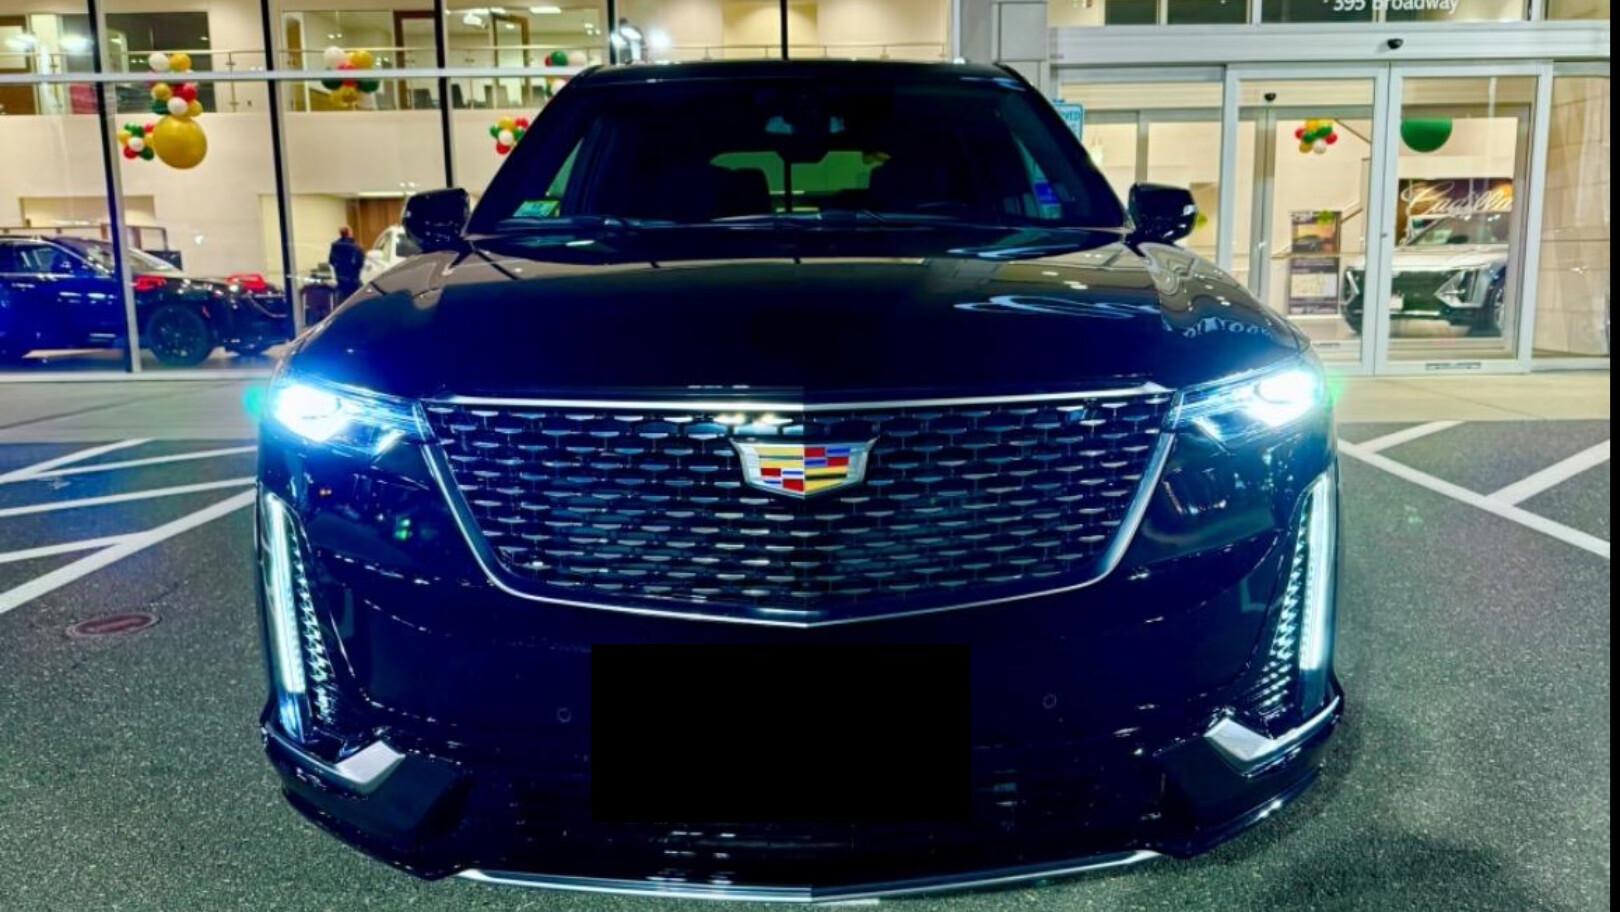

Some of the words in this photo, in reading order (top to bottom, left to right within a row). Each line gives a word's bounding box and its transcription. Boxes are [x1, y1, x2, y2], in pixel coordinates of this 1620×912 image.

[1333, 0, 1366, 11] 395
[1372, 0, 1460, 14] Broadway
[1401, 180, 1512, 217] Cadilla
